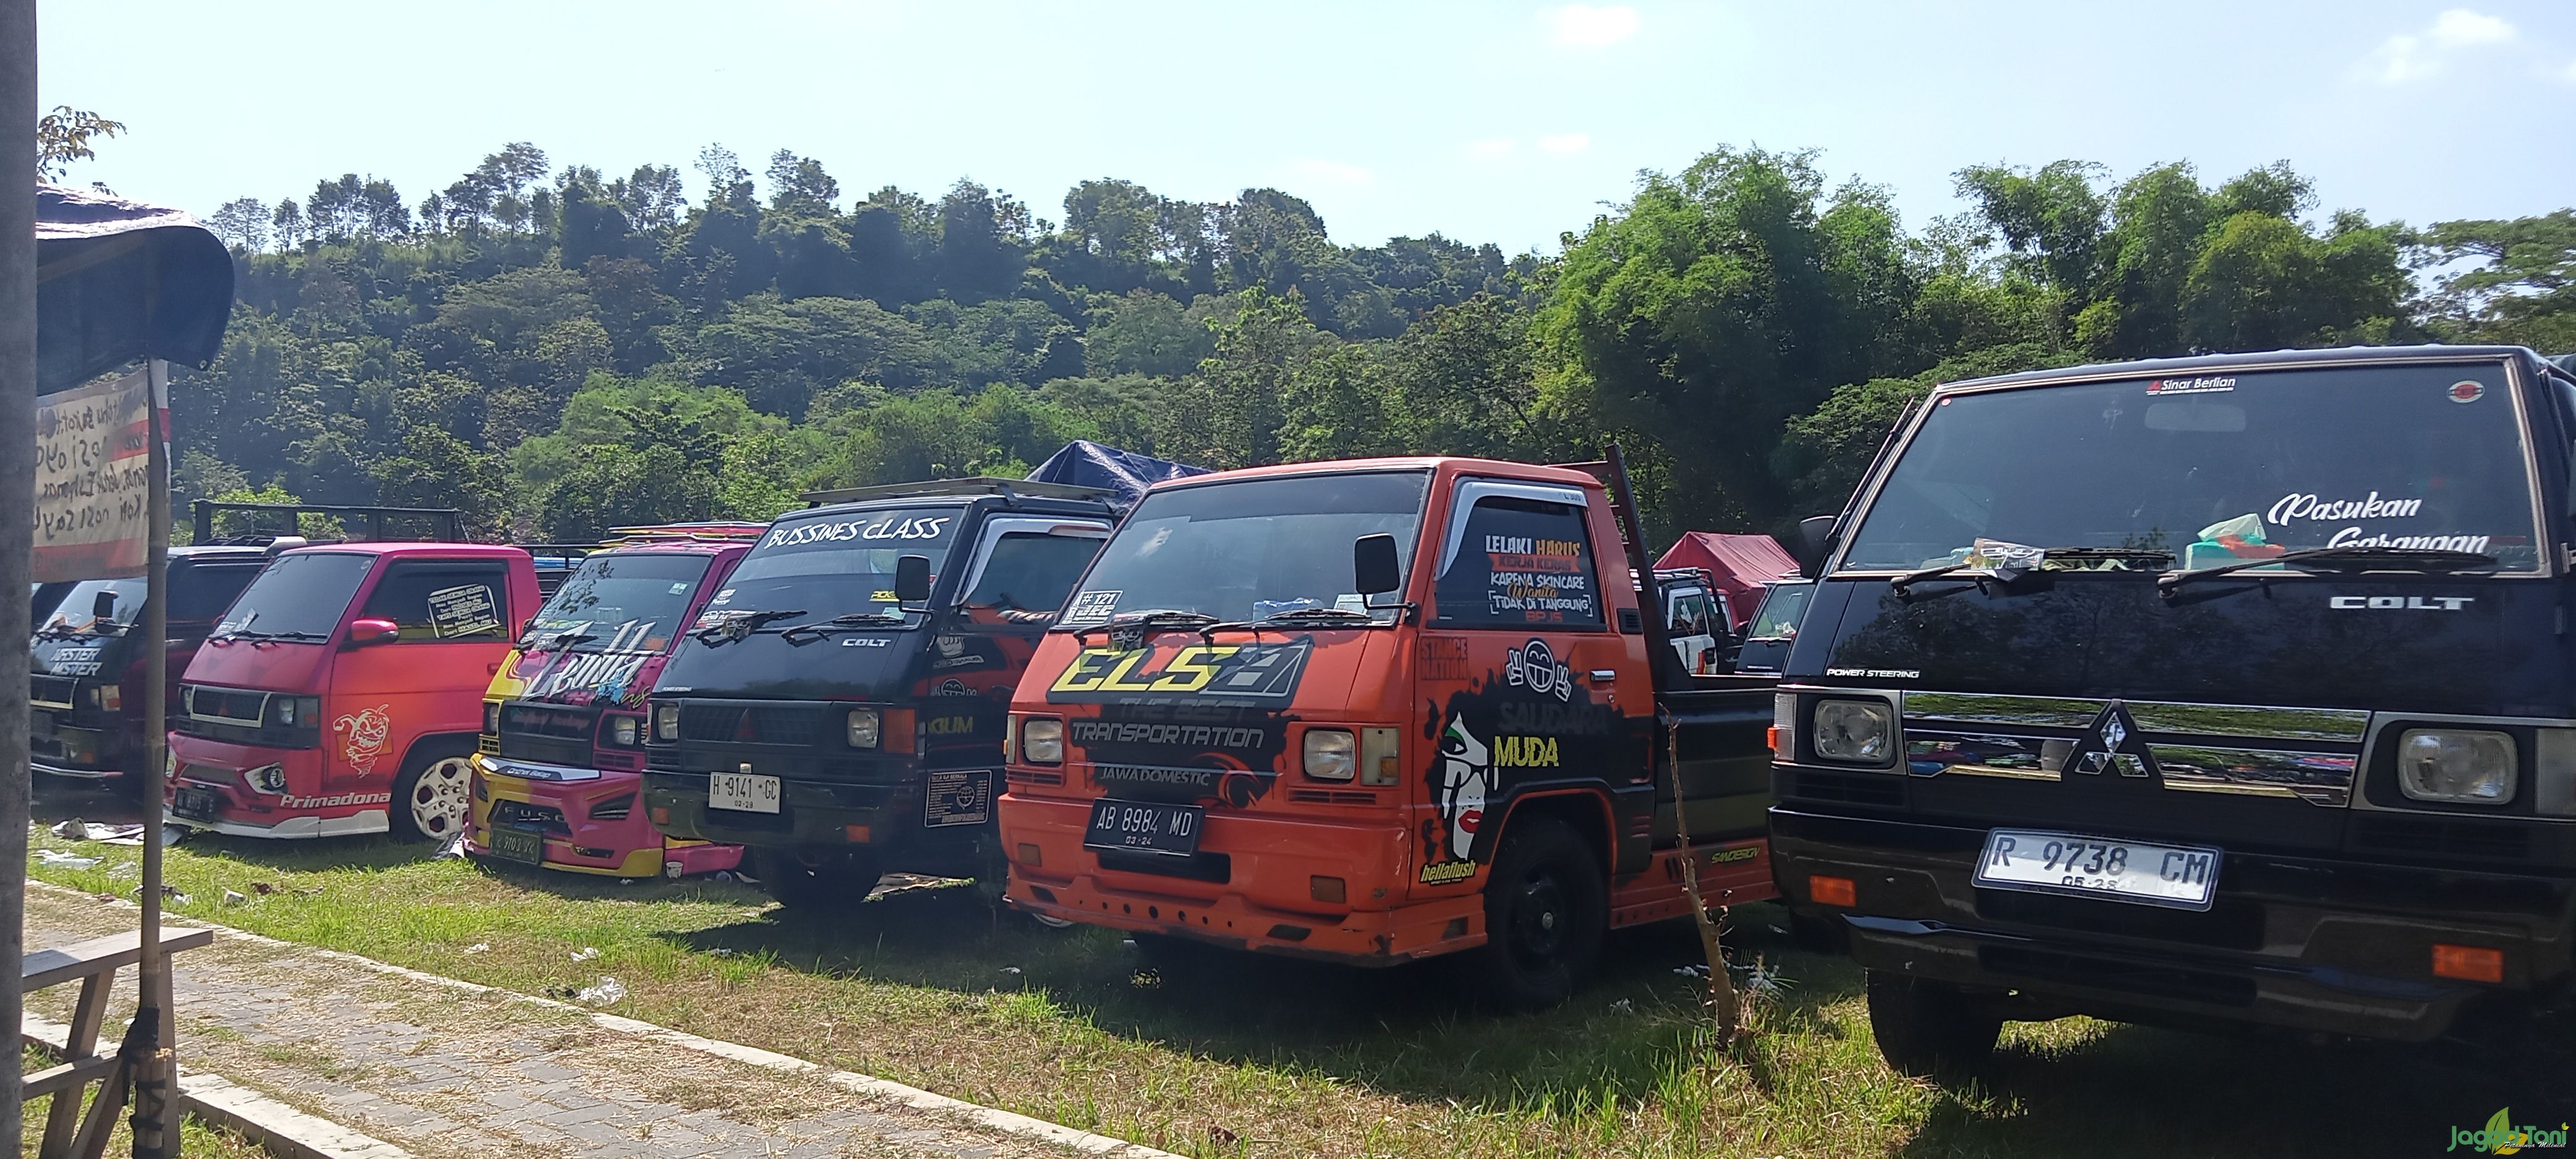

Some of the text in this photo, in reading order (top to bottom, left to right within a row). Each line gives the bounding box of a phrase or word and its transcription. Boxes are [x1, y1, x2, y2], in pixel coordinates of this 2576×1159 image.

[2161, 377, 2236, 390] Sinar Berlian
[2267, 490, 2422, 526] Pasukan
[764, 520, 867, 550] BUSSINES
[1486, 535, 1580, 557] LELAKI HARUS
[1499, 555, 1534, 569] KERJA
[1507, 581, 1559, 599] Wanita
[1536, 574, 1585, 590] SKINCARE
[1093, 593, 1117, 605] 121
[1538, 597, 1589, 612] TANGGUNG
[2330, 596, 2475, 609] COLT
[1526, 610, 1564, 622] BPJS
[842, 638, 892, 647] COLT
[1420, 636, 1468, 659] STANCE
[1866, 670, 1920, 678] STEERING
[1497, 701, 1611, 734] SAUDARA
[1072, 721, 1265, 749] TRANSPORTATION
[1494, 736, 1559, 767] MUDA
[713, 775, 777, 800] H 9141 GC
[280, 792, 391, 809] Primadona
[505, 806, 566, 823] FUSO
[1096, 806, 1193, 836] AB 8984 MD
[1991, 837, 2209, 885] R 9738 CM
[1420, 859, 1476, 882] hellaflush
